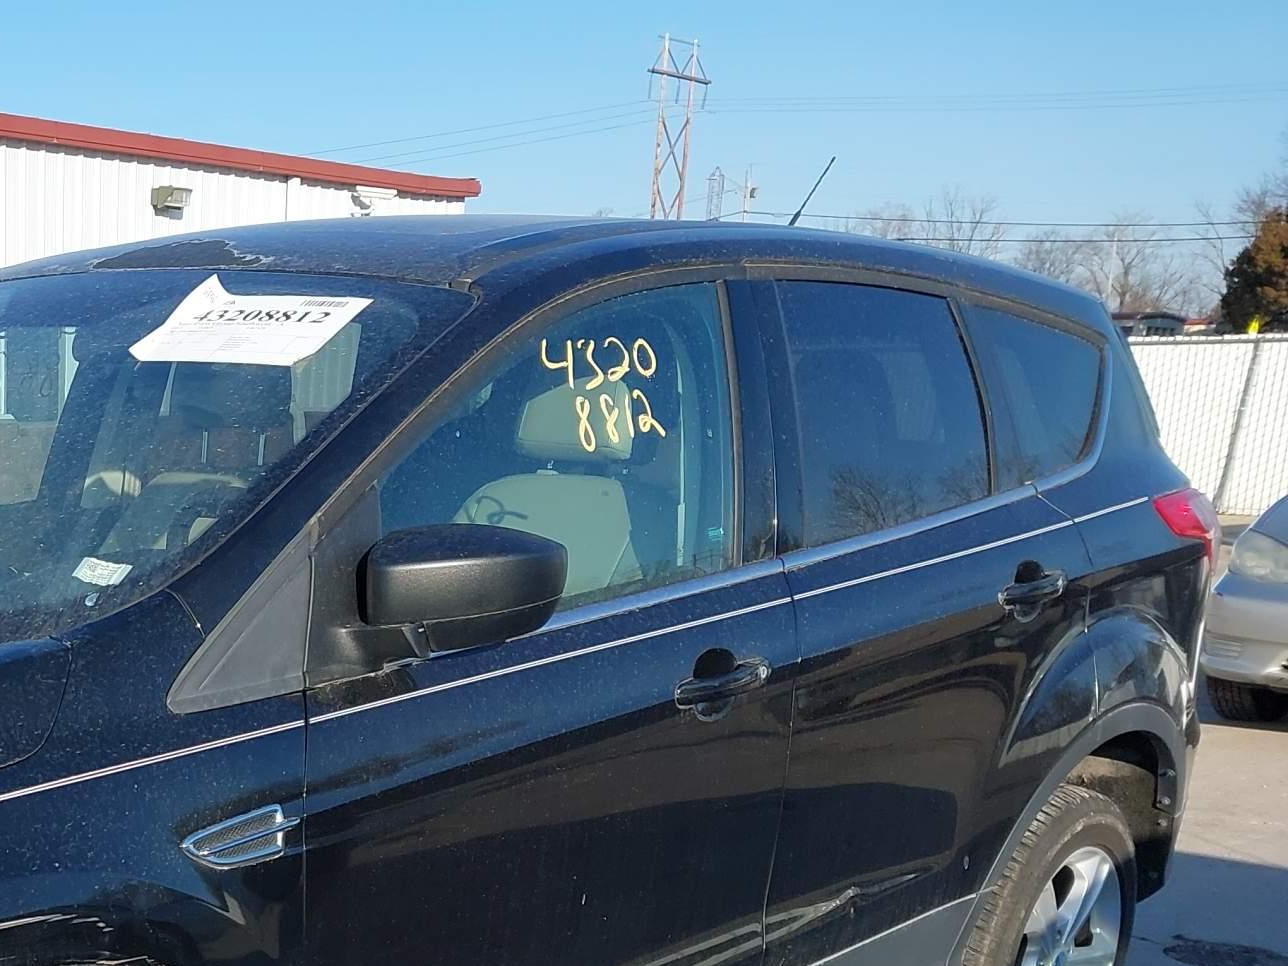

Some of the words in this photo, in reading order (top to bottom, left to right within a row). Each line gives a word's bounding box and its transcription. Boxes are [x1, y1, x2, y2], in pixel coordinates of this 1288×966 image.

[192, 309, 332, 324] 43208812
[541, 336, 657, 391] 4320
[575, 389, 667, 453] 8812
